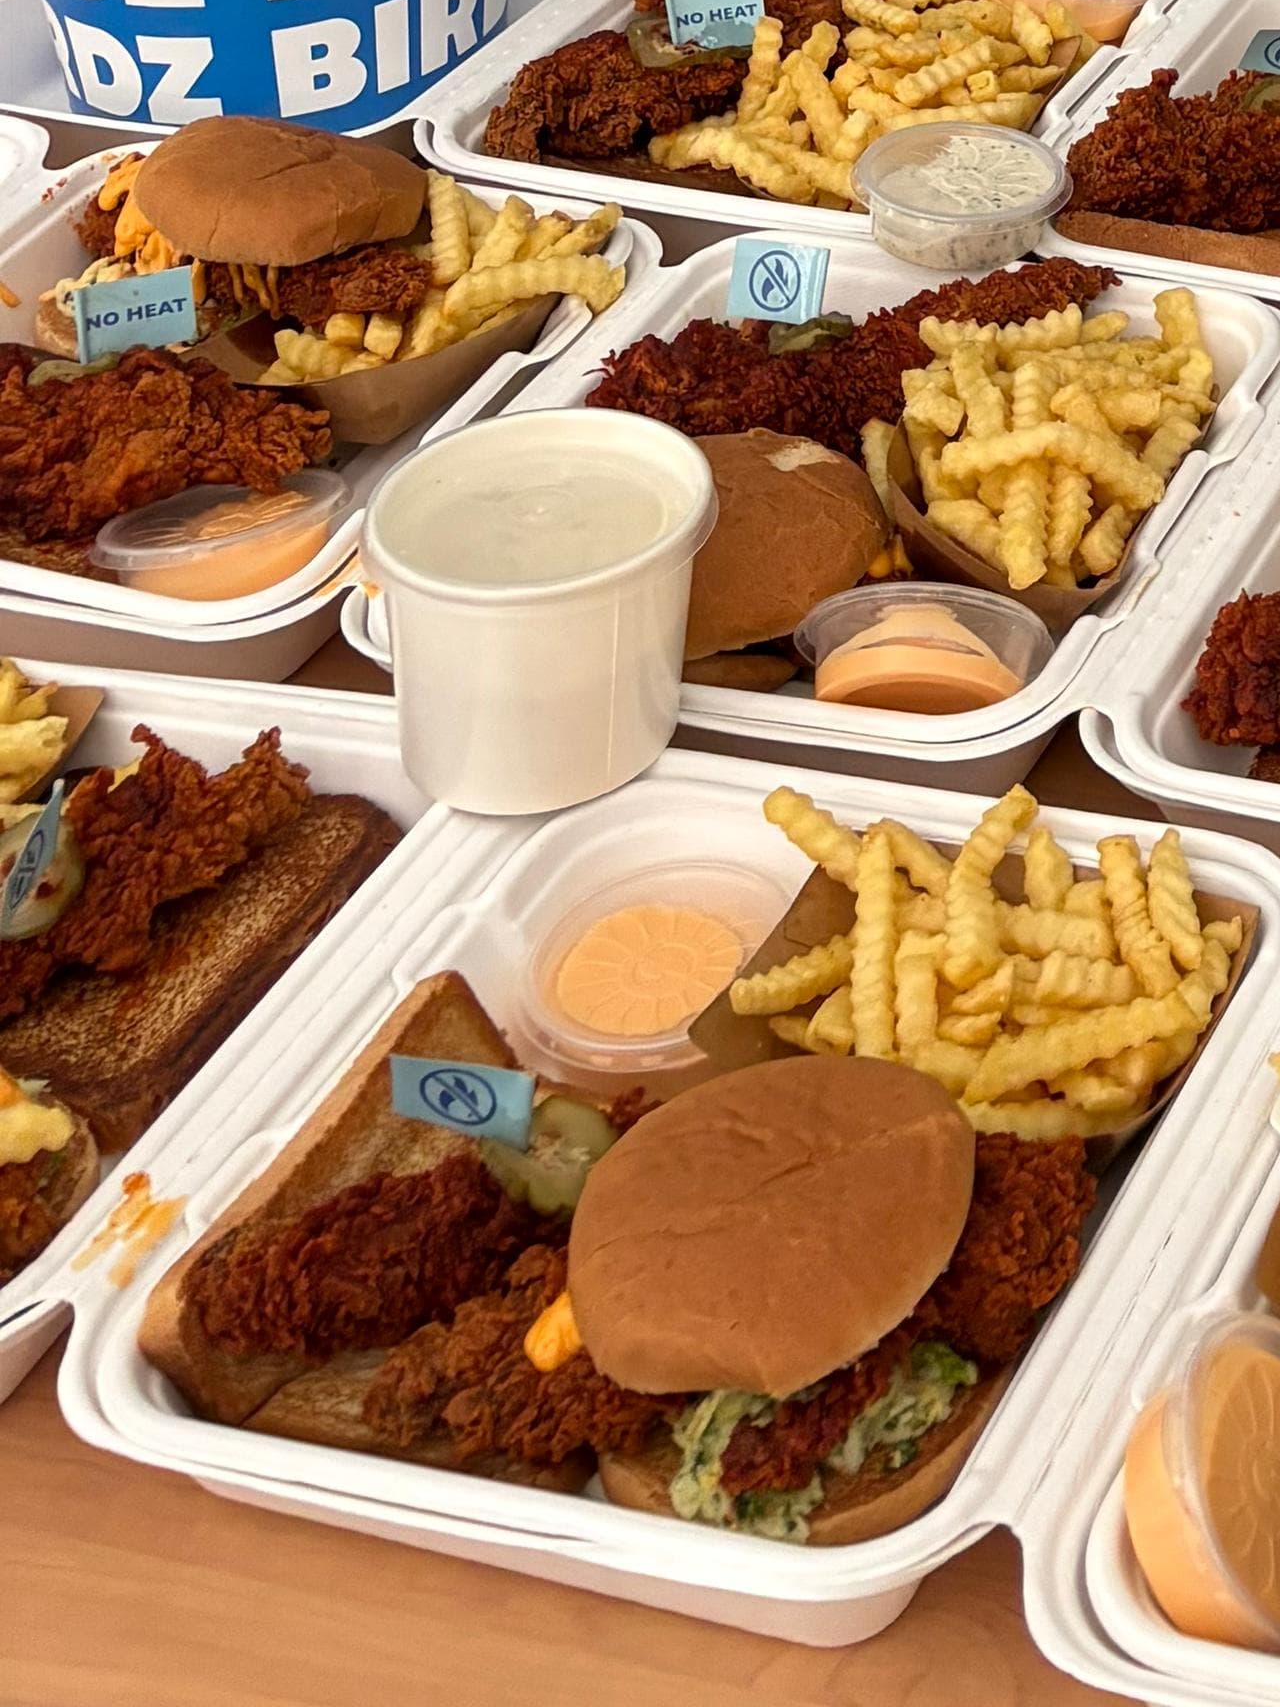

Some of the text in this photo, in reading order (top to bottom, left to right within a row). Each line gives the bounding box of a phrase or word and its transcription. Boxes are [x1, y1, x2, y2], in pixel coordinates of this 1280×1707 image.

[676, 3, 757, 28] NO HEAT
[86, 298, 187, 331] NO HEAT
